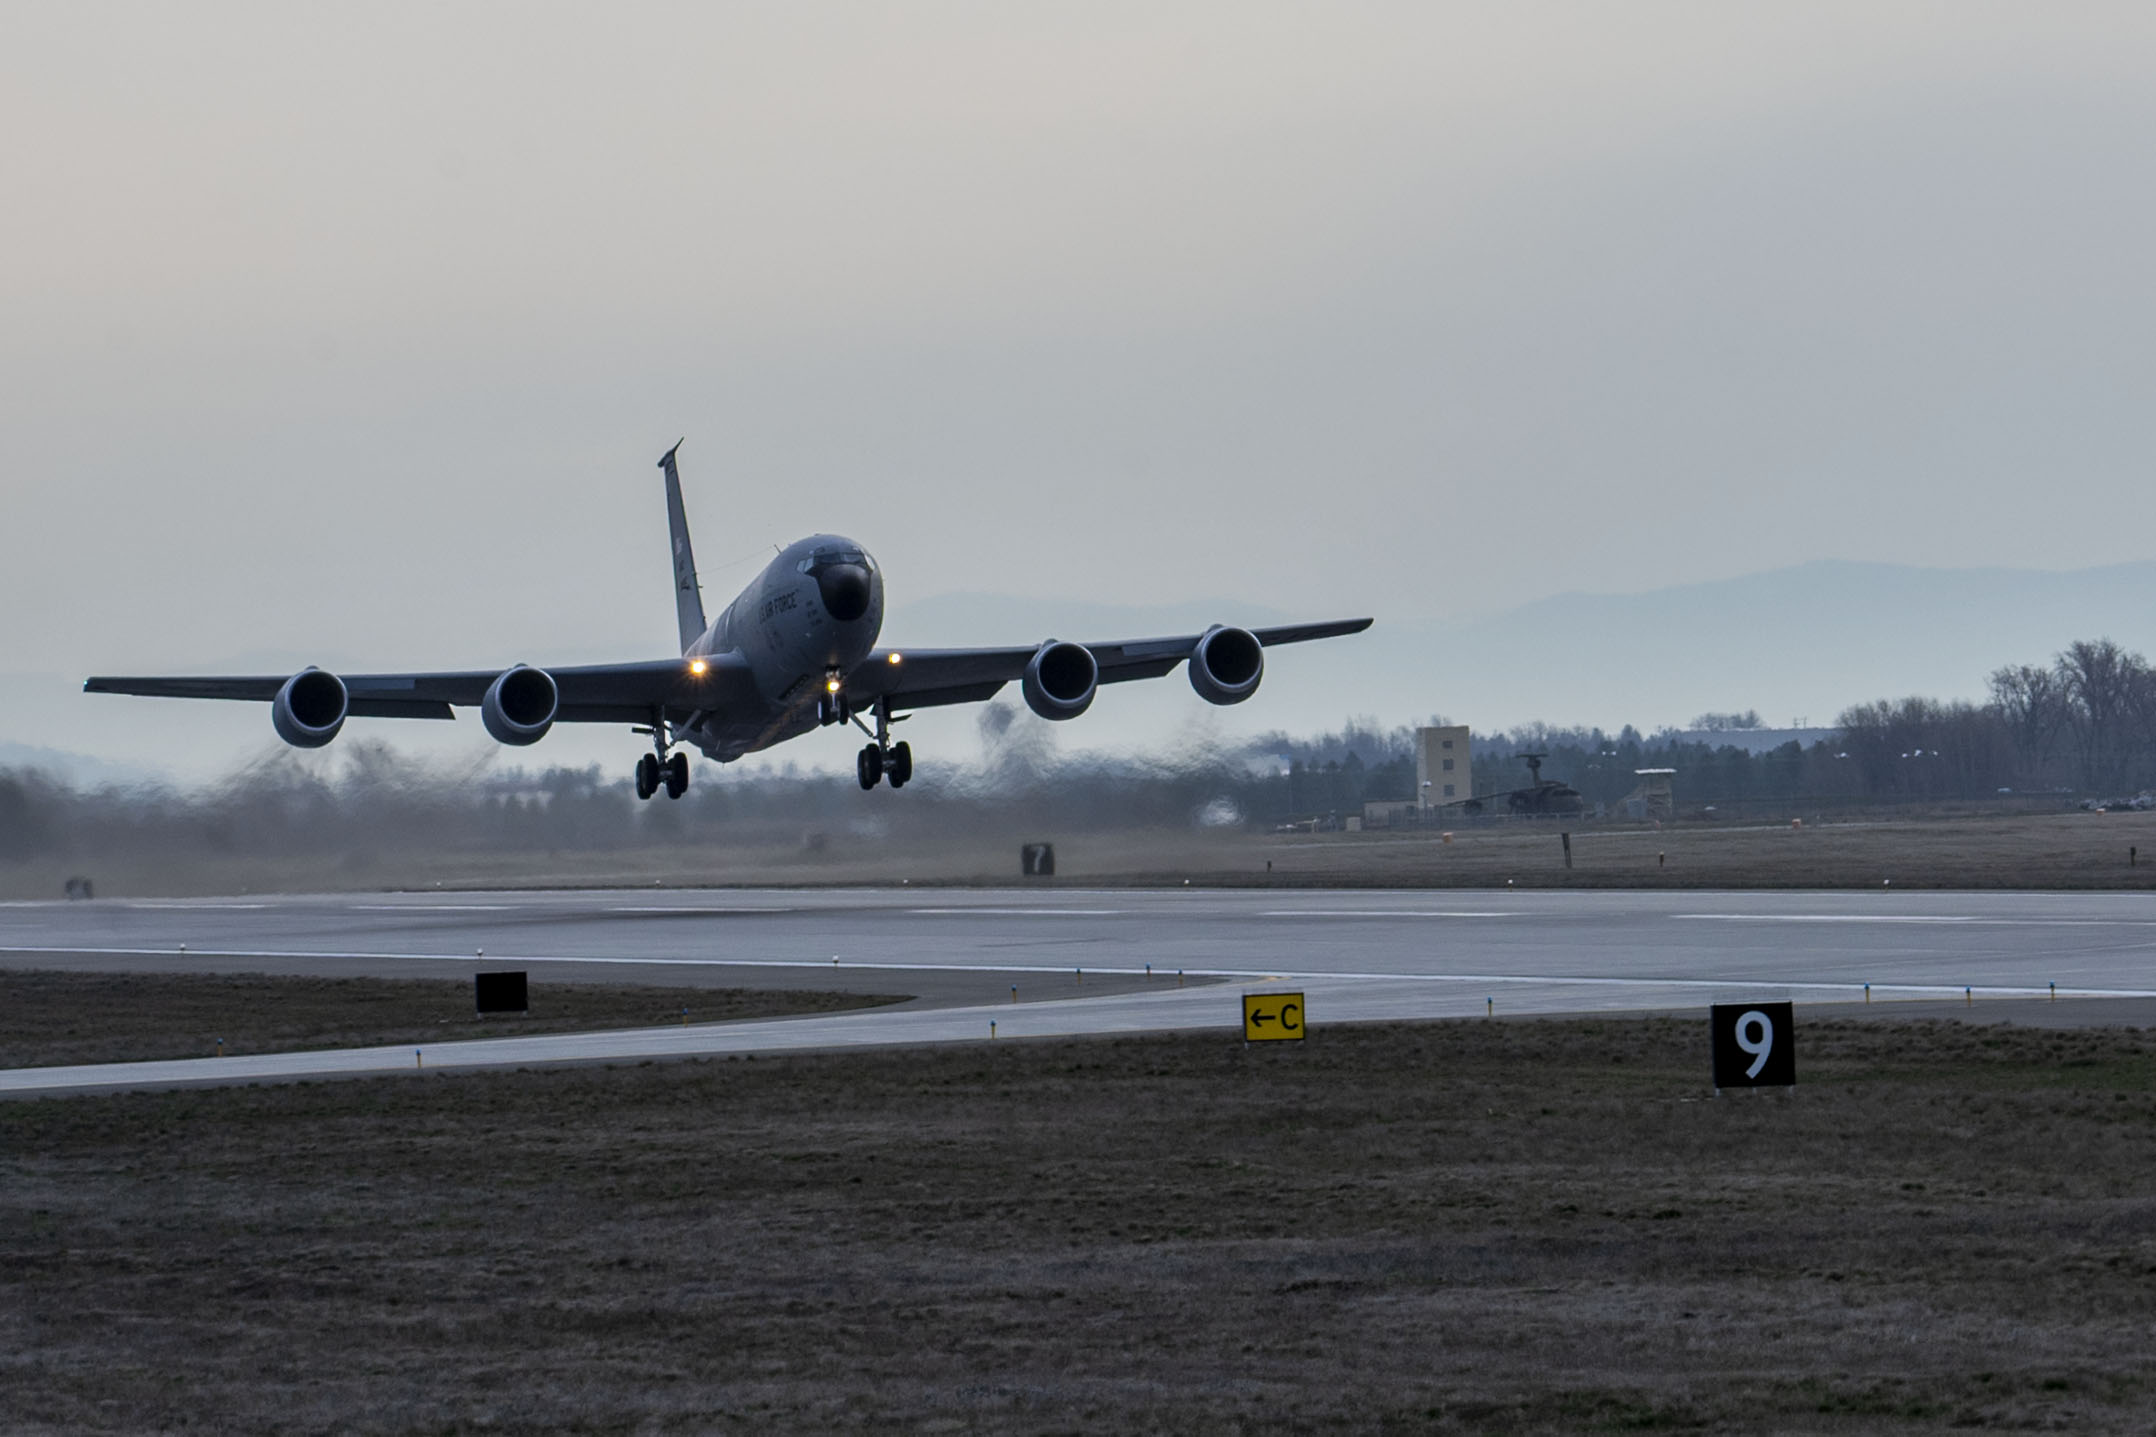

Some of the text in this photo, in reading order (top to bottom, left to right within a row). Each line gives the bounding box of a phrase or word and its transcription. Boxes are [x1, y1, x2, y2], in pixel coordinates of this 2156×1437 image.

[774, 591, 797, 615] FORCE
[1031, 846, 1046, 872] 7
[1281, 1004, 1298, 1030] C
[1735, 1010, 1774, 1079] 9
